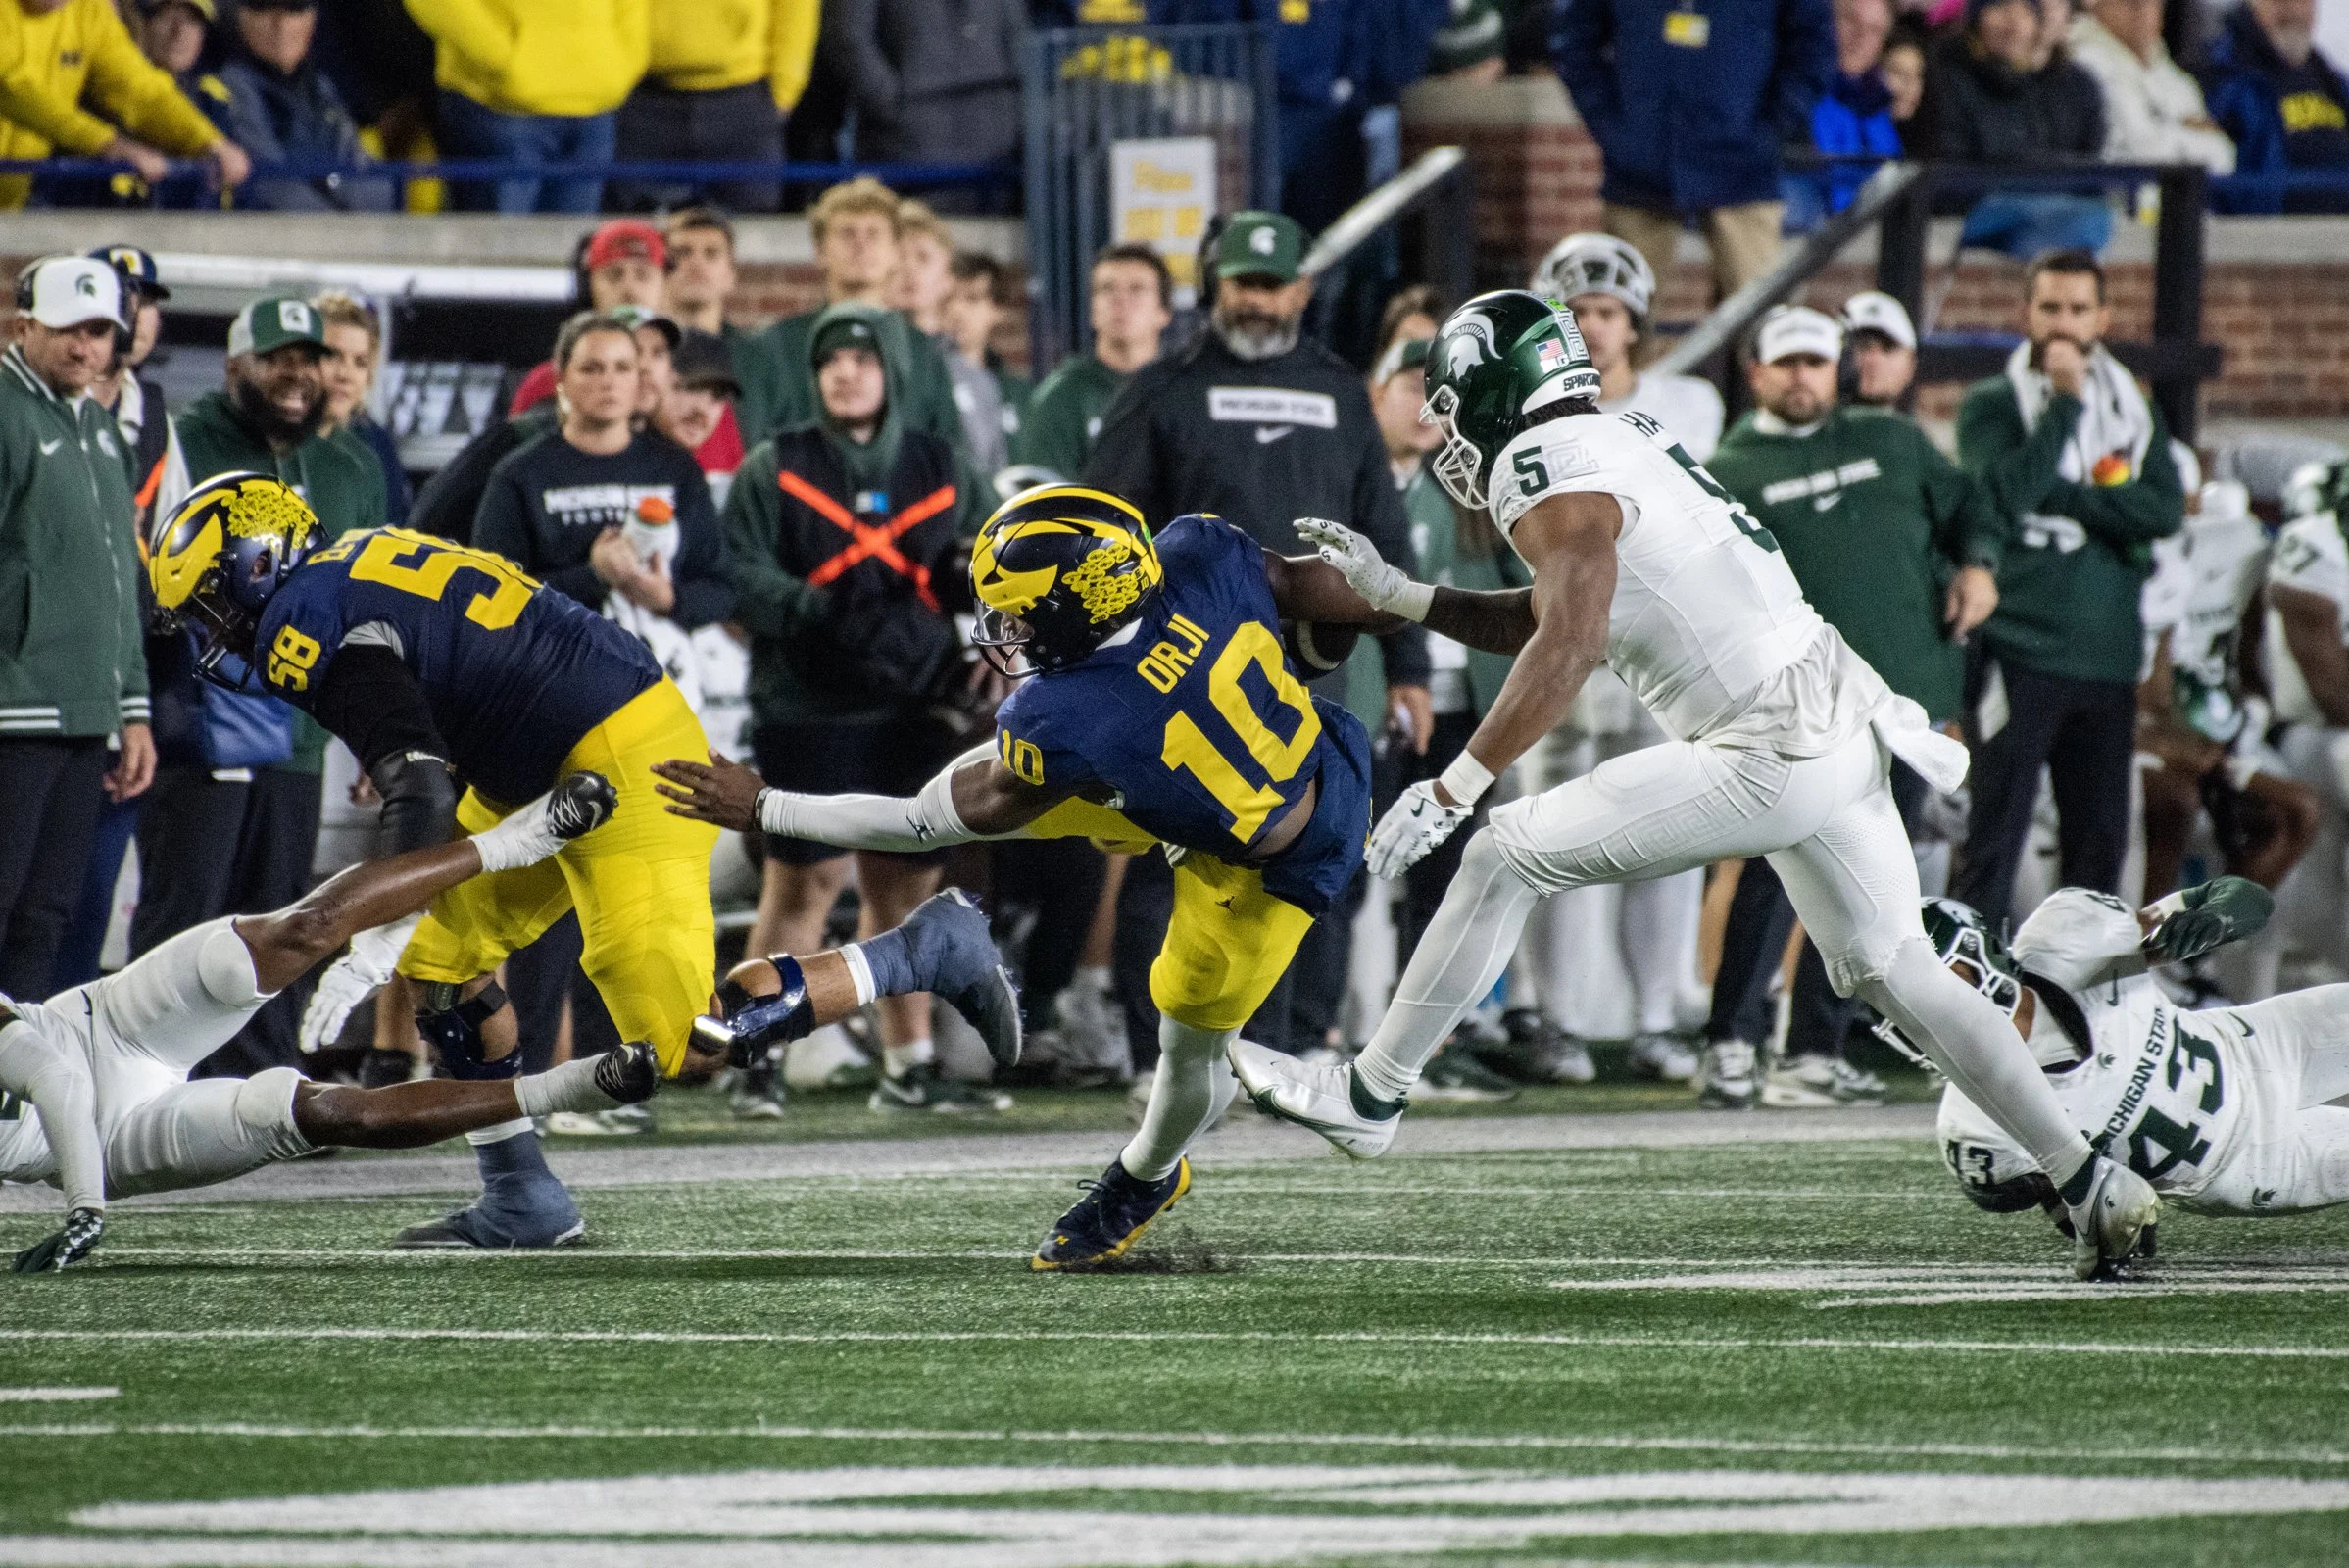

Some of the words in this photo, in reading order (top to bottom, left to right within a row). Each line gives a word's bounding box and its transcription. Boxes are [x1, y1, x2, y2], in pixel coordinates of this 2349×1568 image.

[1512, 445, 1550, 497] 5
[267, 624, 321, 692] 58
[1137, 612, 1210, 694] ORJI
[1002, 729, 1045, 786] 10
[1160, 620, 1322, 844] 10
[2103, 1056, 2157, 1139] ICHIGAN
[2129, 1013, 2224, 1179] 43
